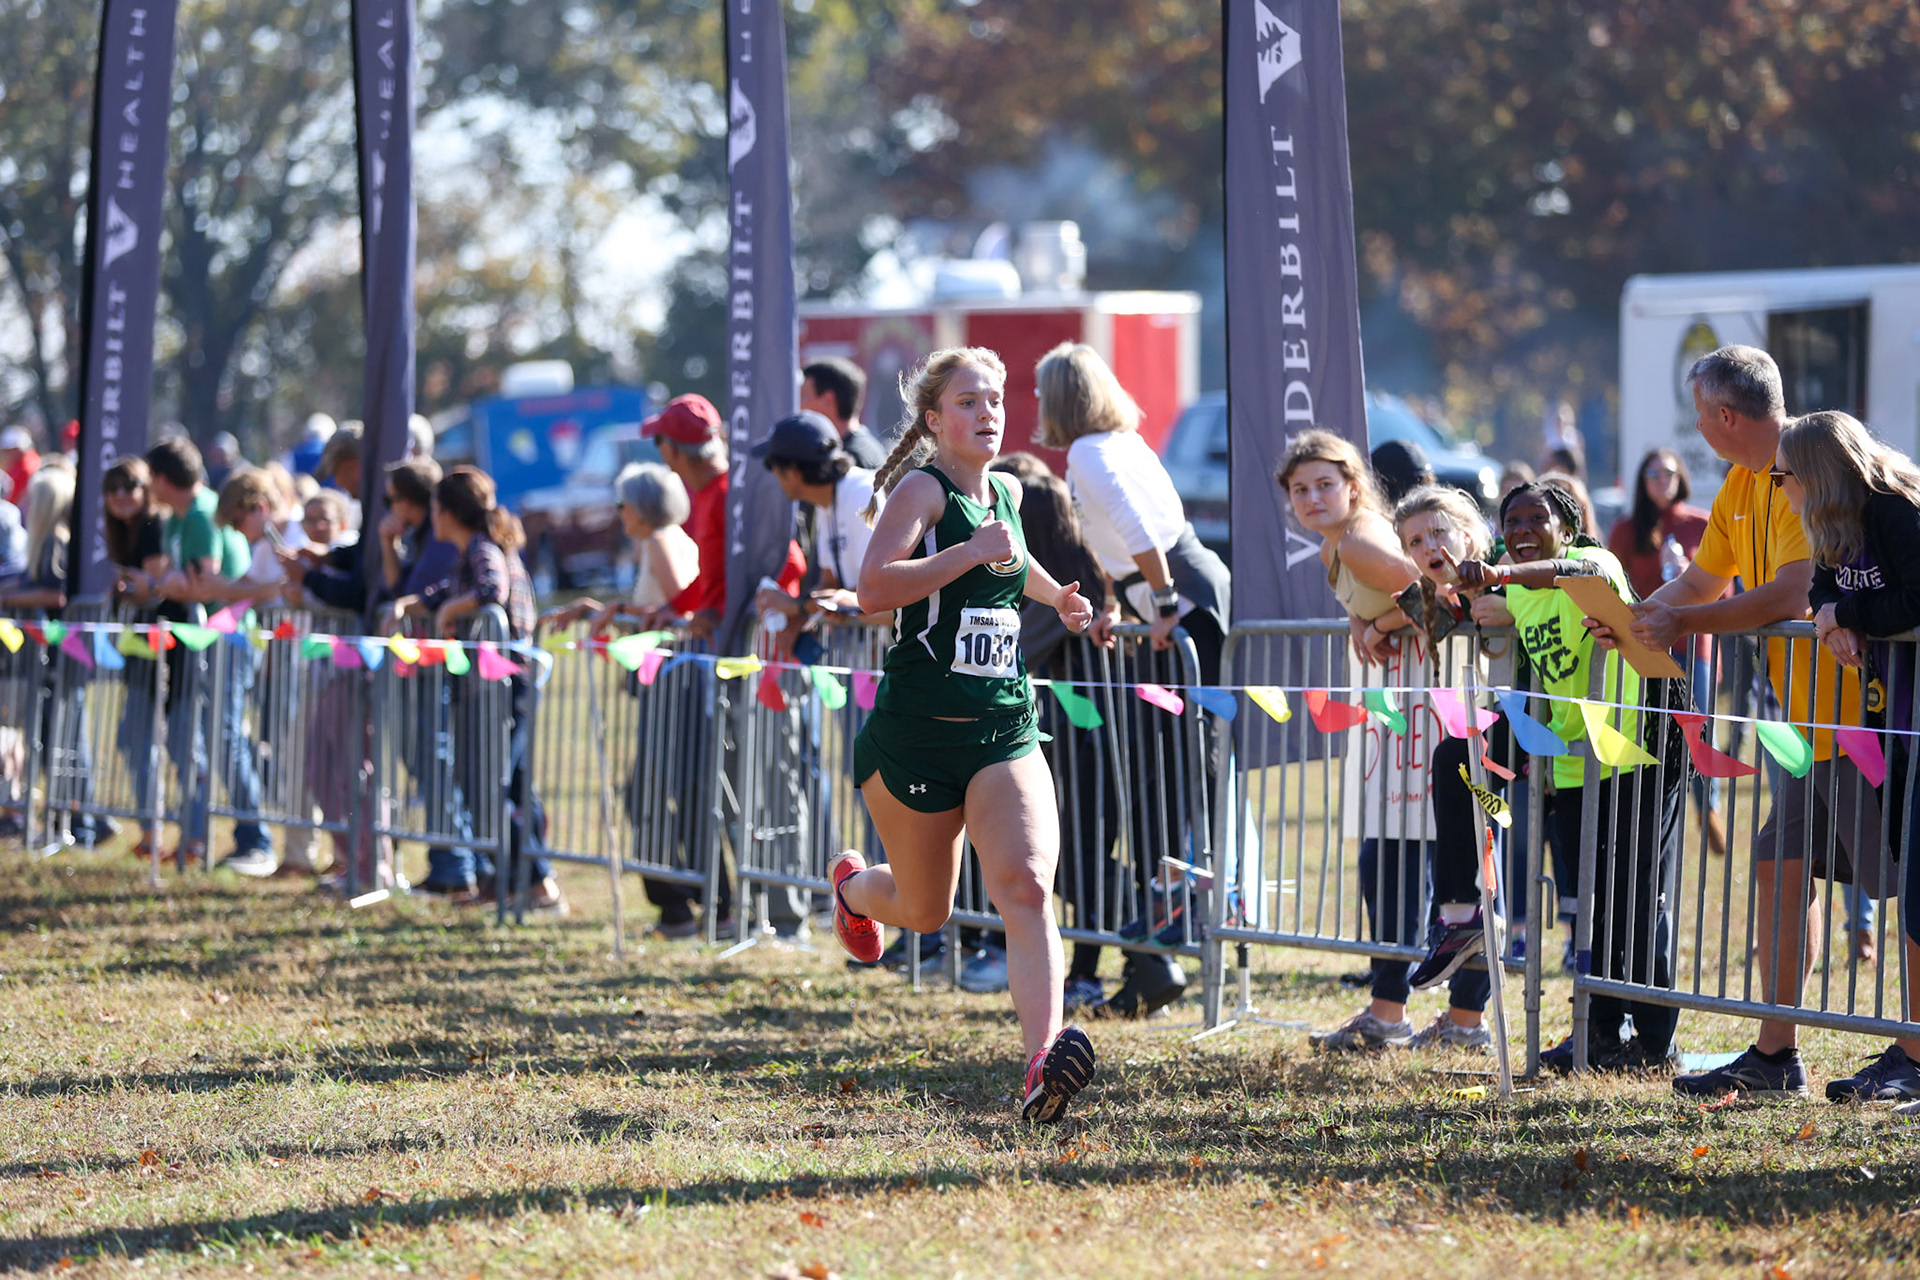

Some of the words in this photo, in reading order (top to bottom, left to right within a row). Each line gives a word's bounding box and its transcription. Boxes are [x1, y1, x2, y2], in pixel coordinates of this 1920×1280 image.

[117, 7, 148, 189] HEALTH
[1270, 125, 1321, 570] VDERBILT
[960, 632, 1014, 668] 1033
[969, 615, 994, 626] TMSAA
